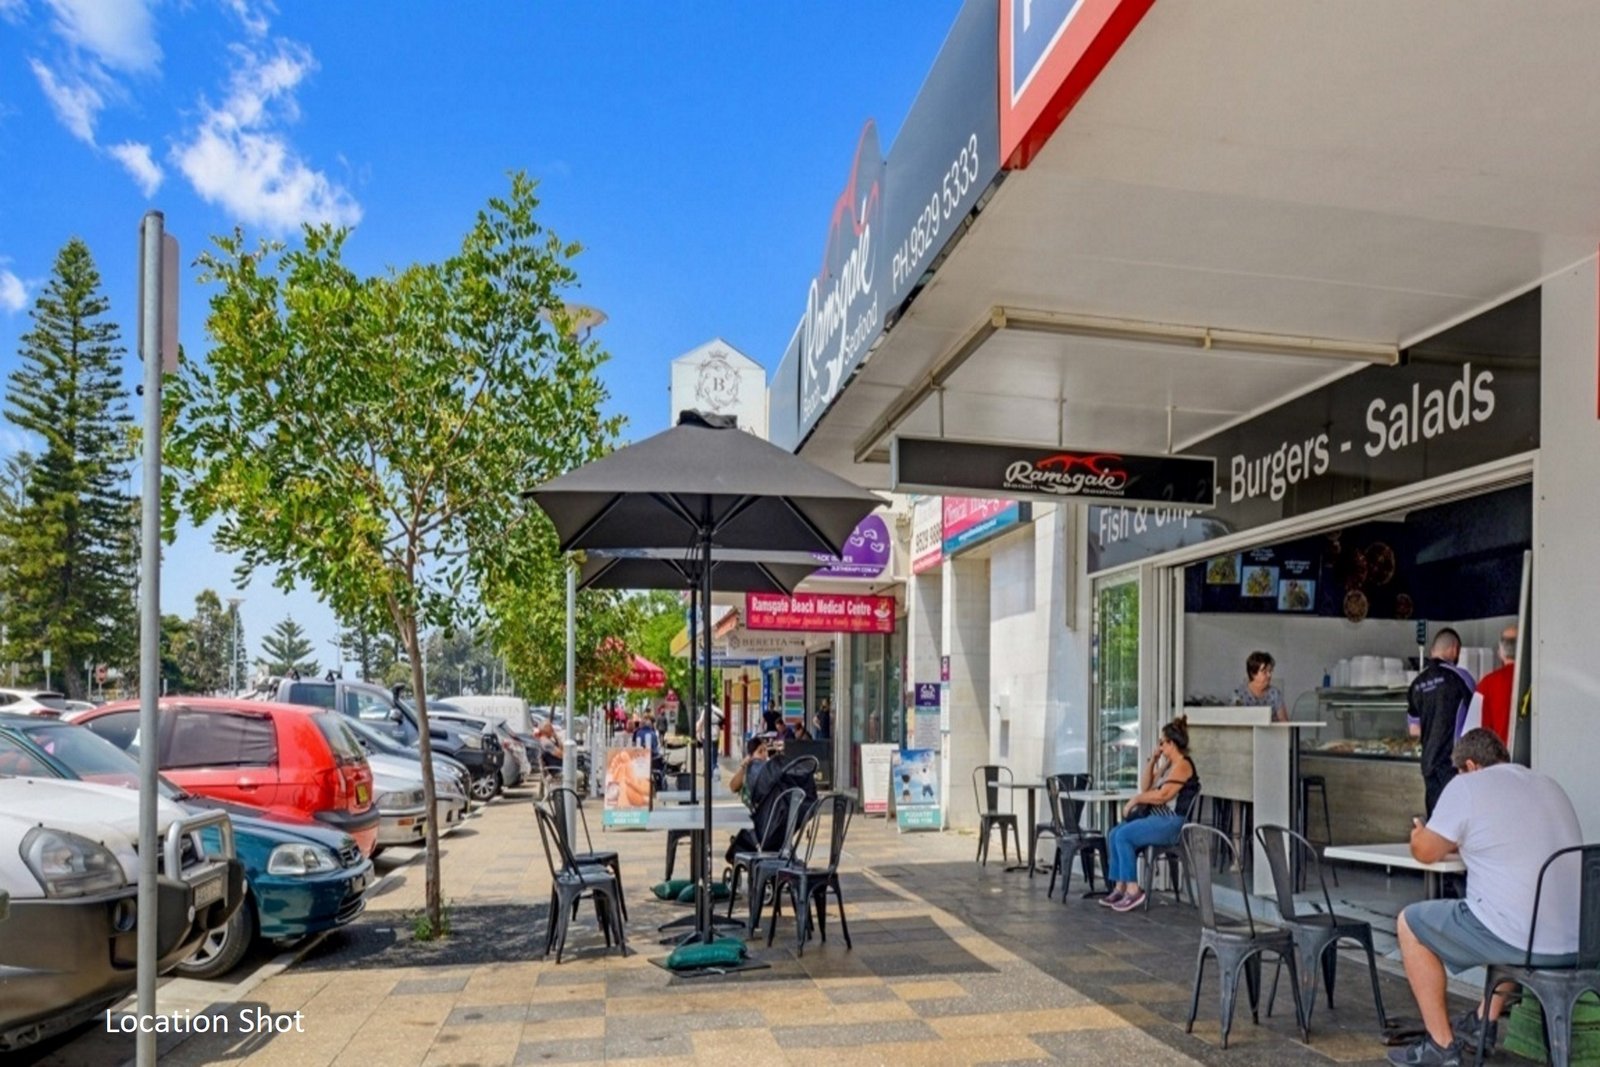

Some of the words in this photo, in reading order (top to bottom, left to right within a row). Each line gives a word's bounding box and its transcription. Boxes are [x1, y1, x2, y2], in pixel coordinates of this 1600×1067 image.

[892, 192, 940, 294] PH.9529
[943, 133, 979, 221] 5333
[844, 290, 878, 366] Seafood
[1231, 431, 1330, 504] Burgers
[1364, 362, 1496, 459] Salads
[1099, 505, 1130, 546] Fish
[1133, 506, 1148, 534] &
[751, 596, 789, 616] Ramsgate
[791, 598, 815, 614] Beach
[816, 599, 846, 615] Medical
[846, 600, 872, 616] Centre
